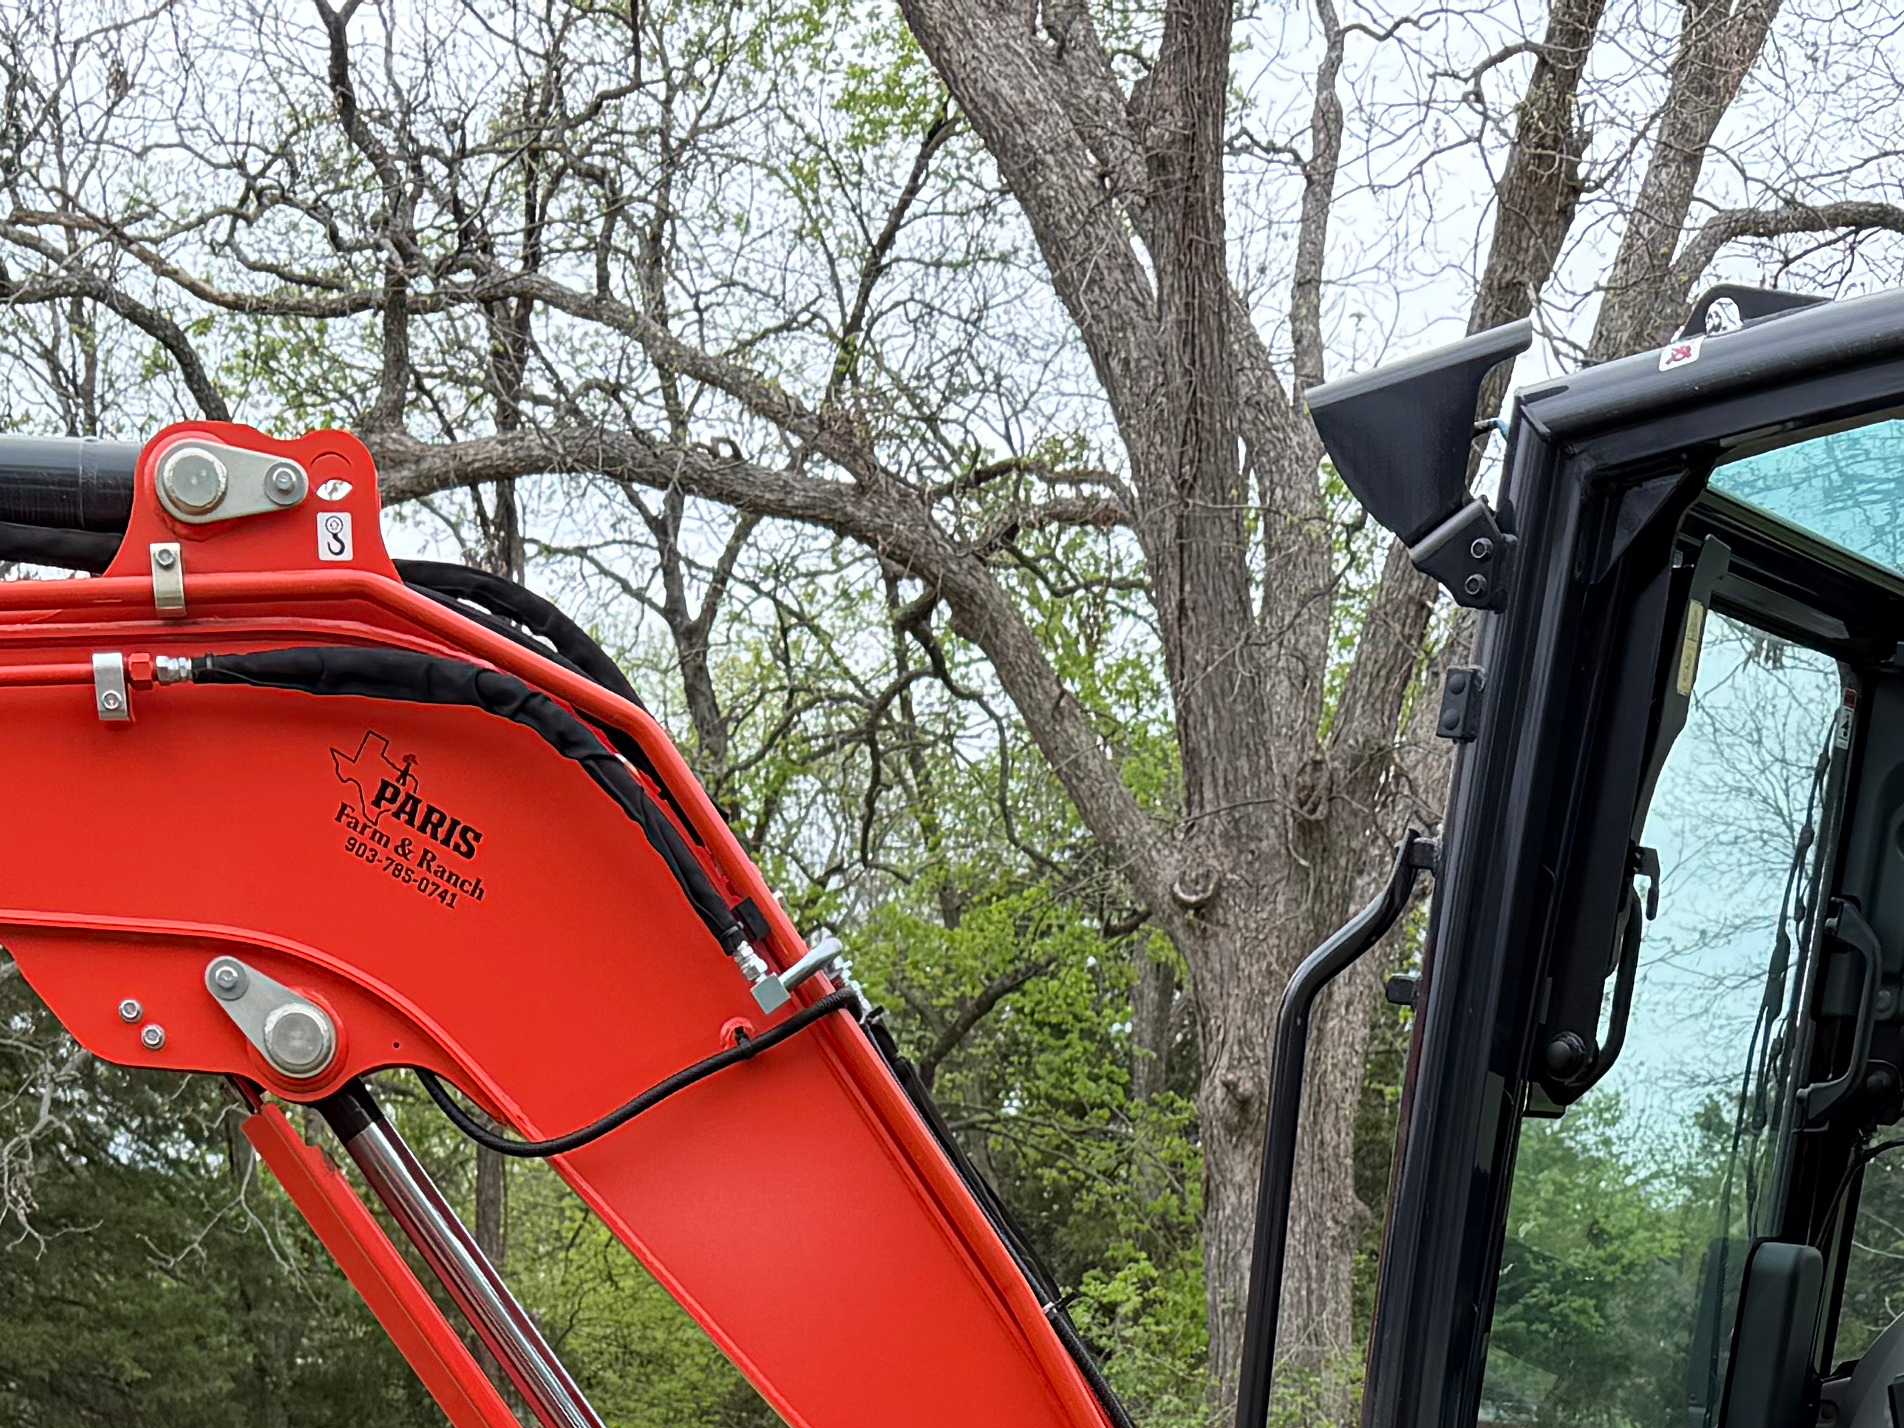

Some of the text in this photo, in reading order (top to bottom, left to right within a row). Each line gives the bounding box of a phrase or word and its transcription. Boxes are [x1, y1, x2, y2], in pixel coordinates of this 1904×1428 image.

[334, 801, 486, 902] Farm & Ranch
[370, 777, 484, 860] PARIS
[344, 836, 459, 910] 903-785-0741
